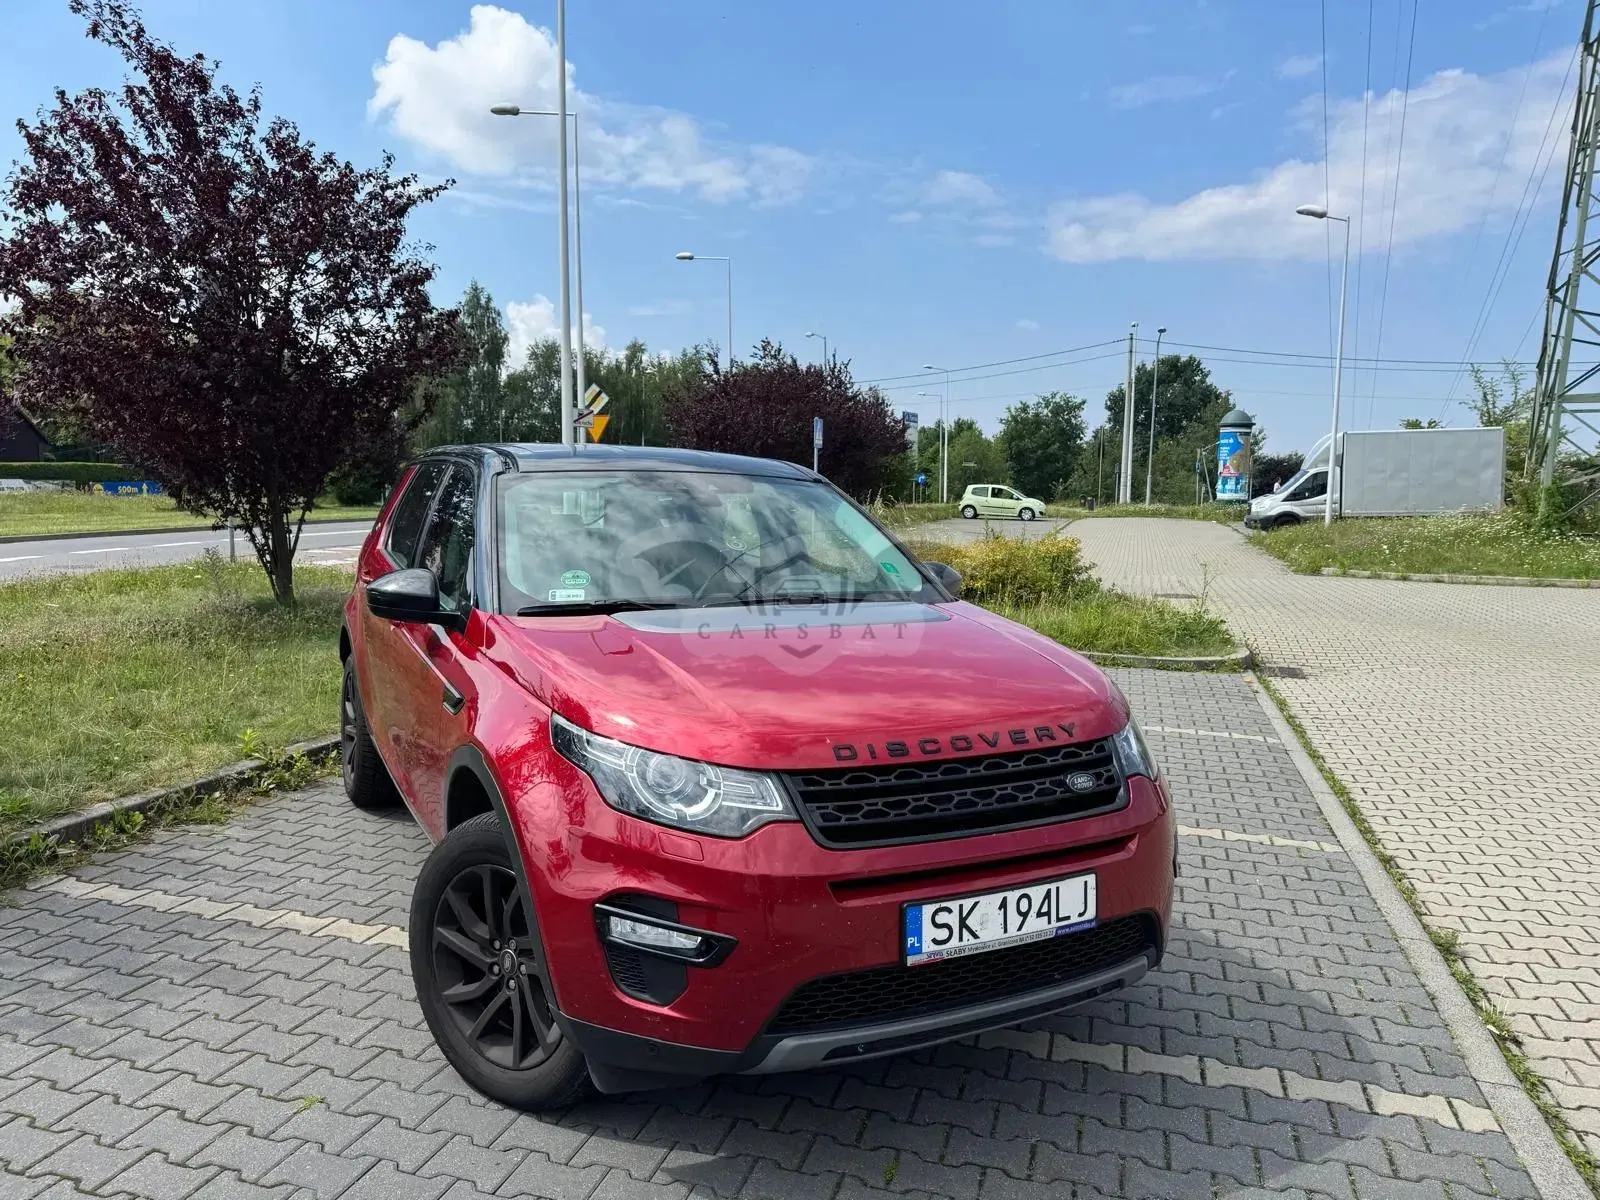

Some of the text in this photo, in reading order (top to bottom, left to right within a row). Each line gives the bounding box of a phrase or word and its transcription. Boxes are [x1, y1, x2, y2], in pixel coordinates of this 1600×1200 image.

[832, 722, 1076, 762] DISCOVERY
[930, 880, 1088, 946] SK 194LJ
[907, 937, 921, 948] PL
